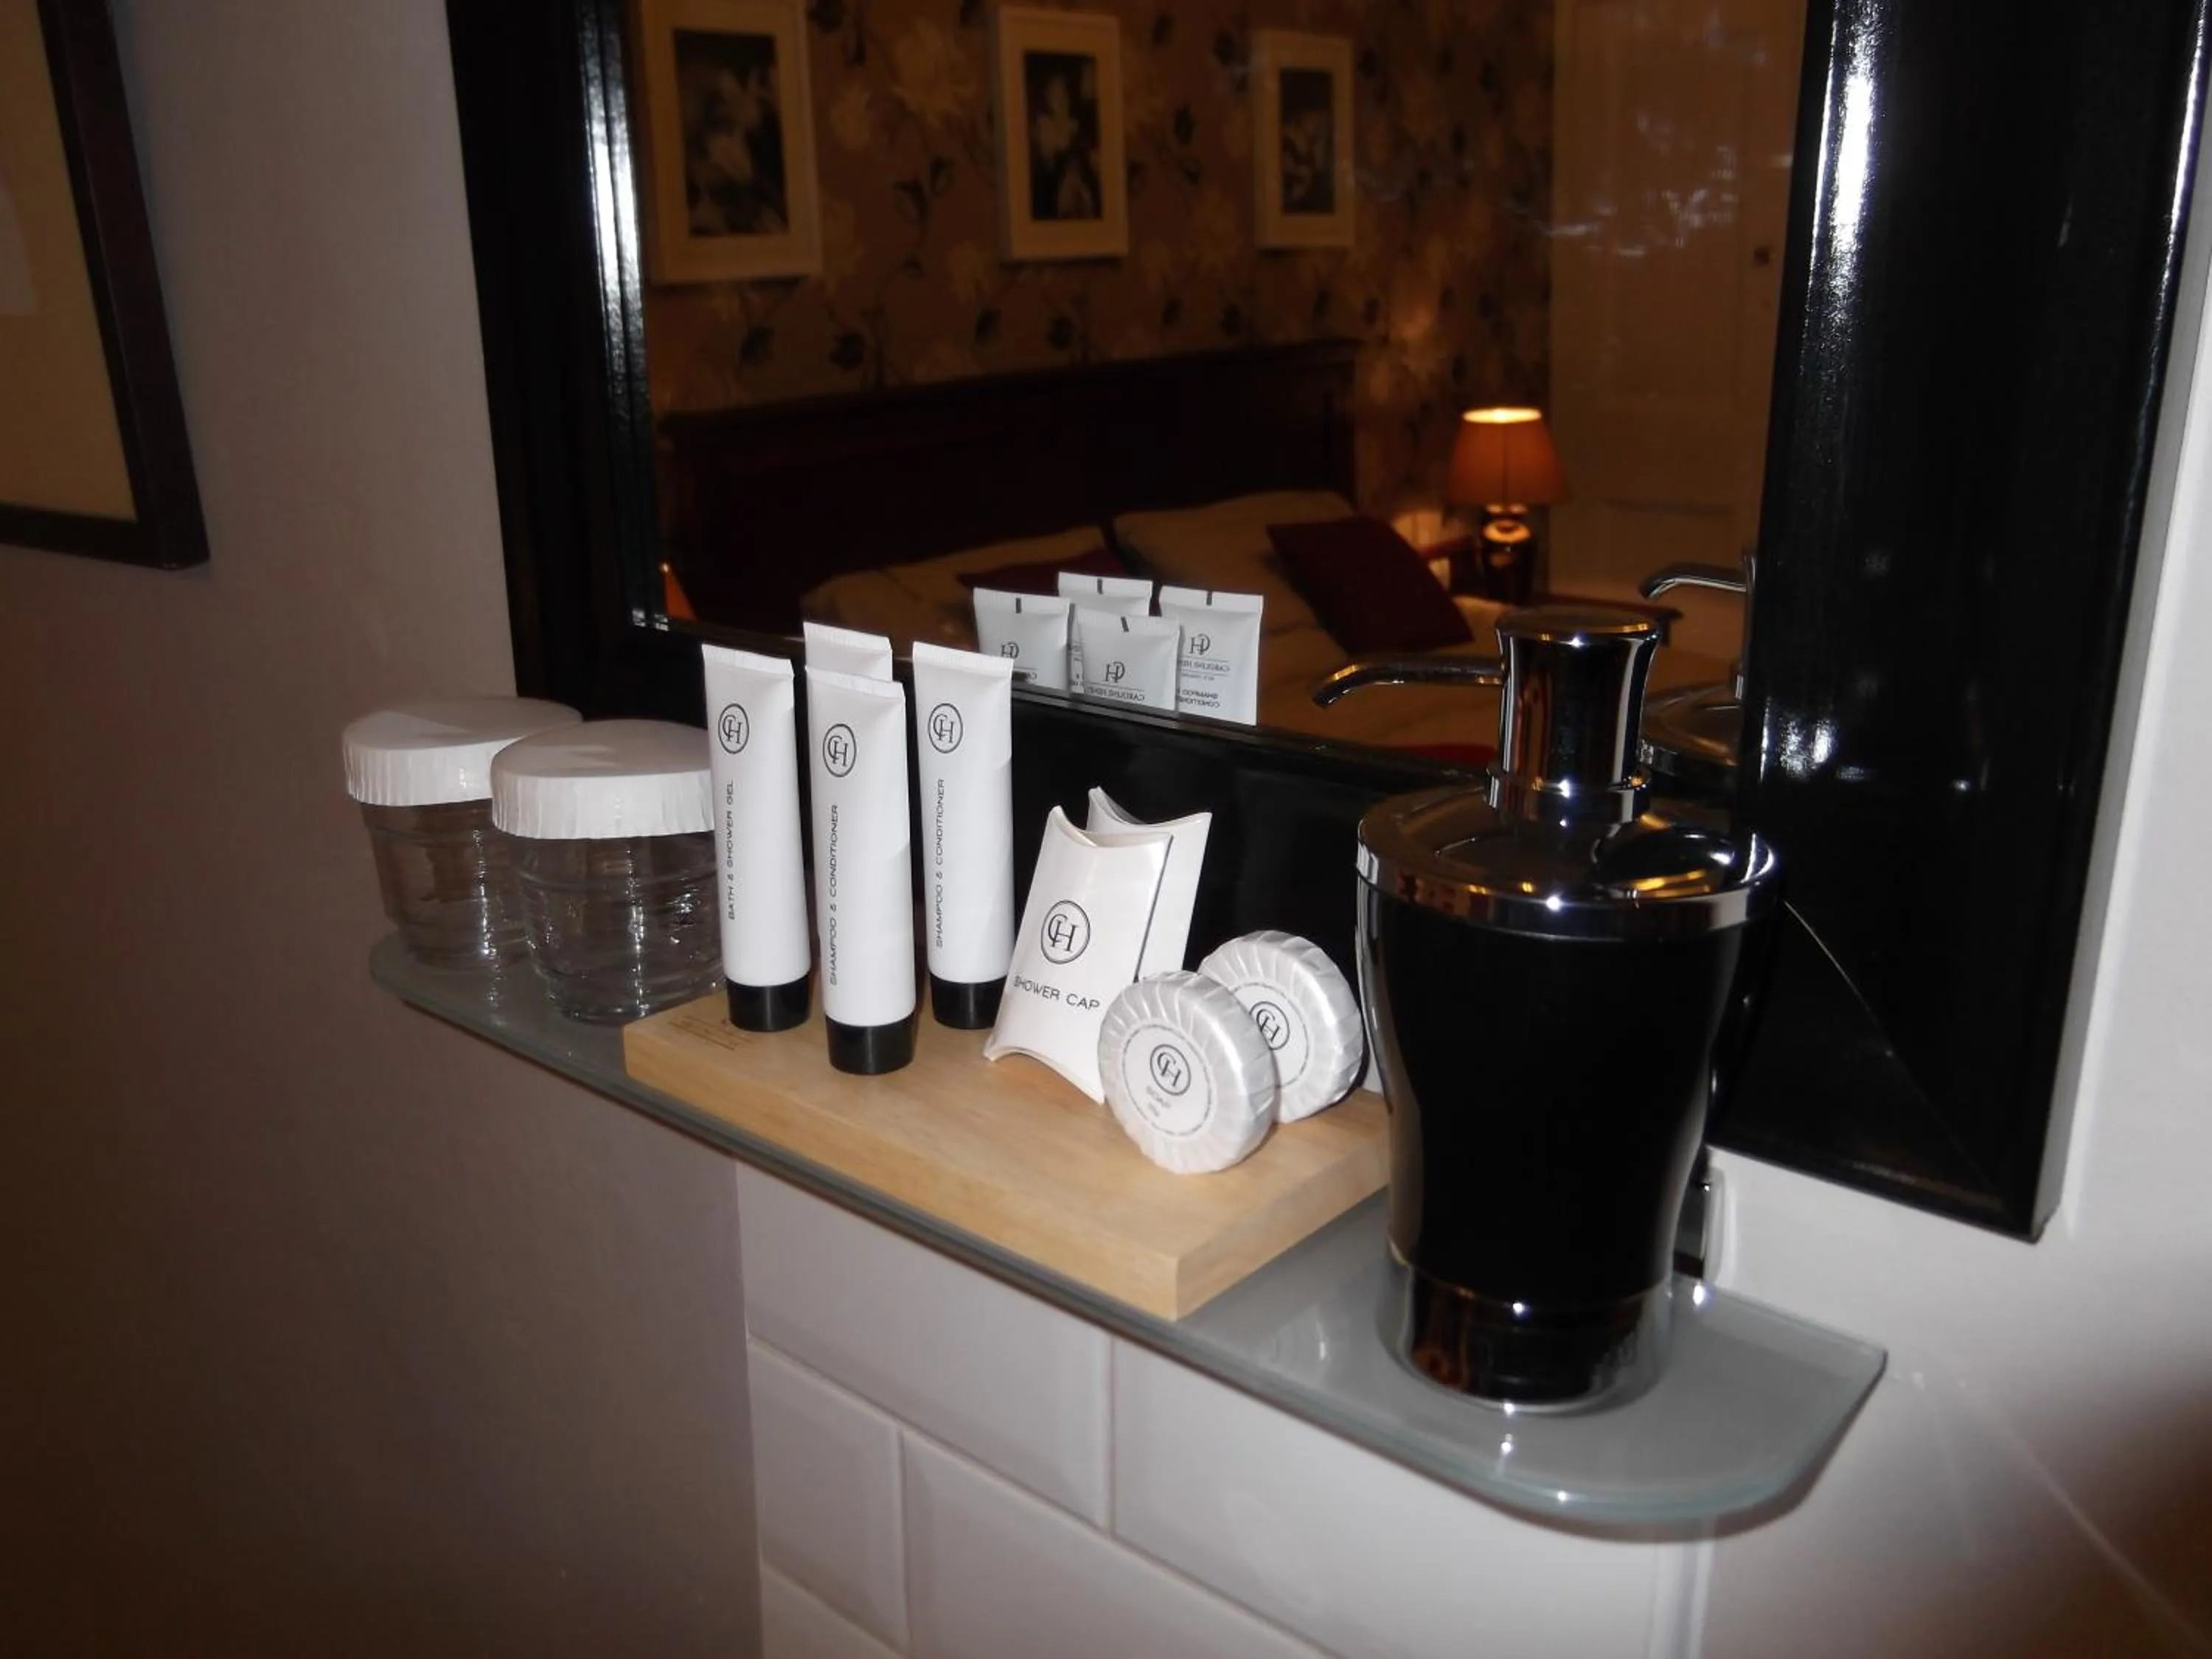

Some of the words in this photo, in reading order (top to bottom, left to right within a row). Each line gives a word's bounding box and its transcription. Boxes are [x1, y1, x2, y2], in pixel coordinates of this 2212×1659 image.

[726, 779, 734, 806] GEL
[936, 778, 945, 866] CONDITIONER
[726, 810, 734, 869] SHOWER
[830, 804, 838, 898] CONDITIONER
[728, 886, 736, 920] BATH
[935, 884, 943, 948] SHAMPOO
[830, 917, 838, 987] SHAMPOO
[1014, 975, 1060, 1000] SHOWER
[1065, 993, 1100, 1011] CAP
